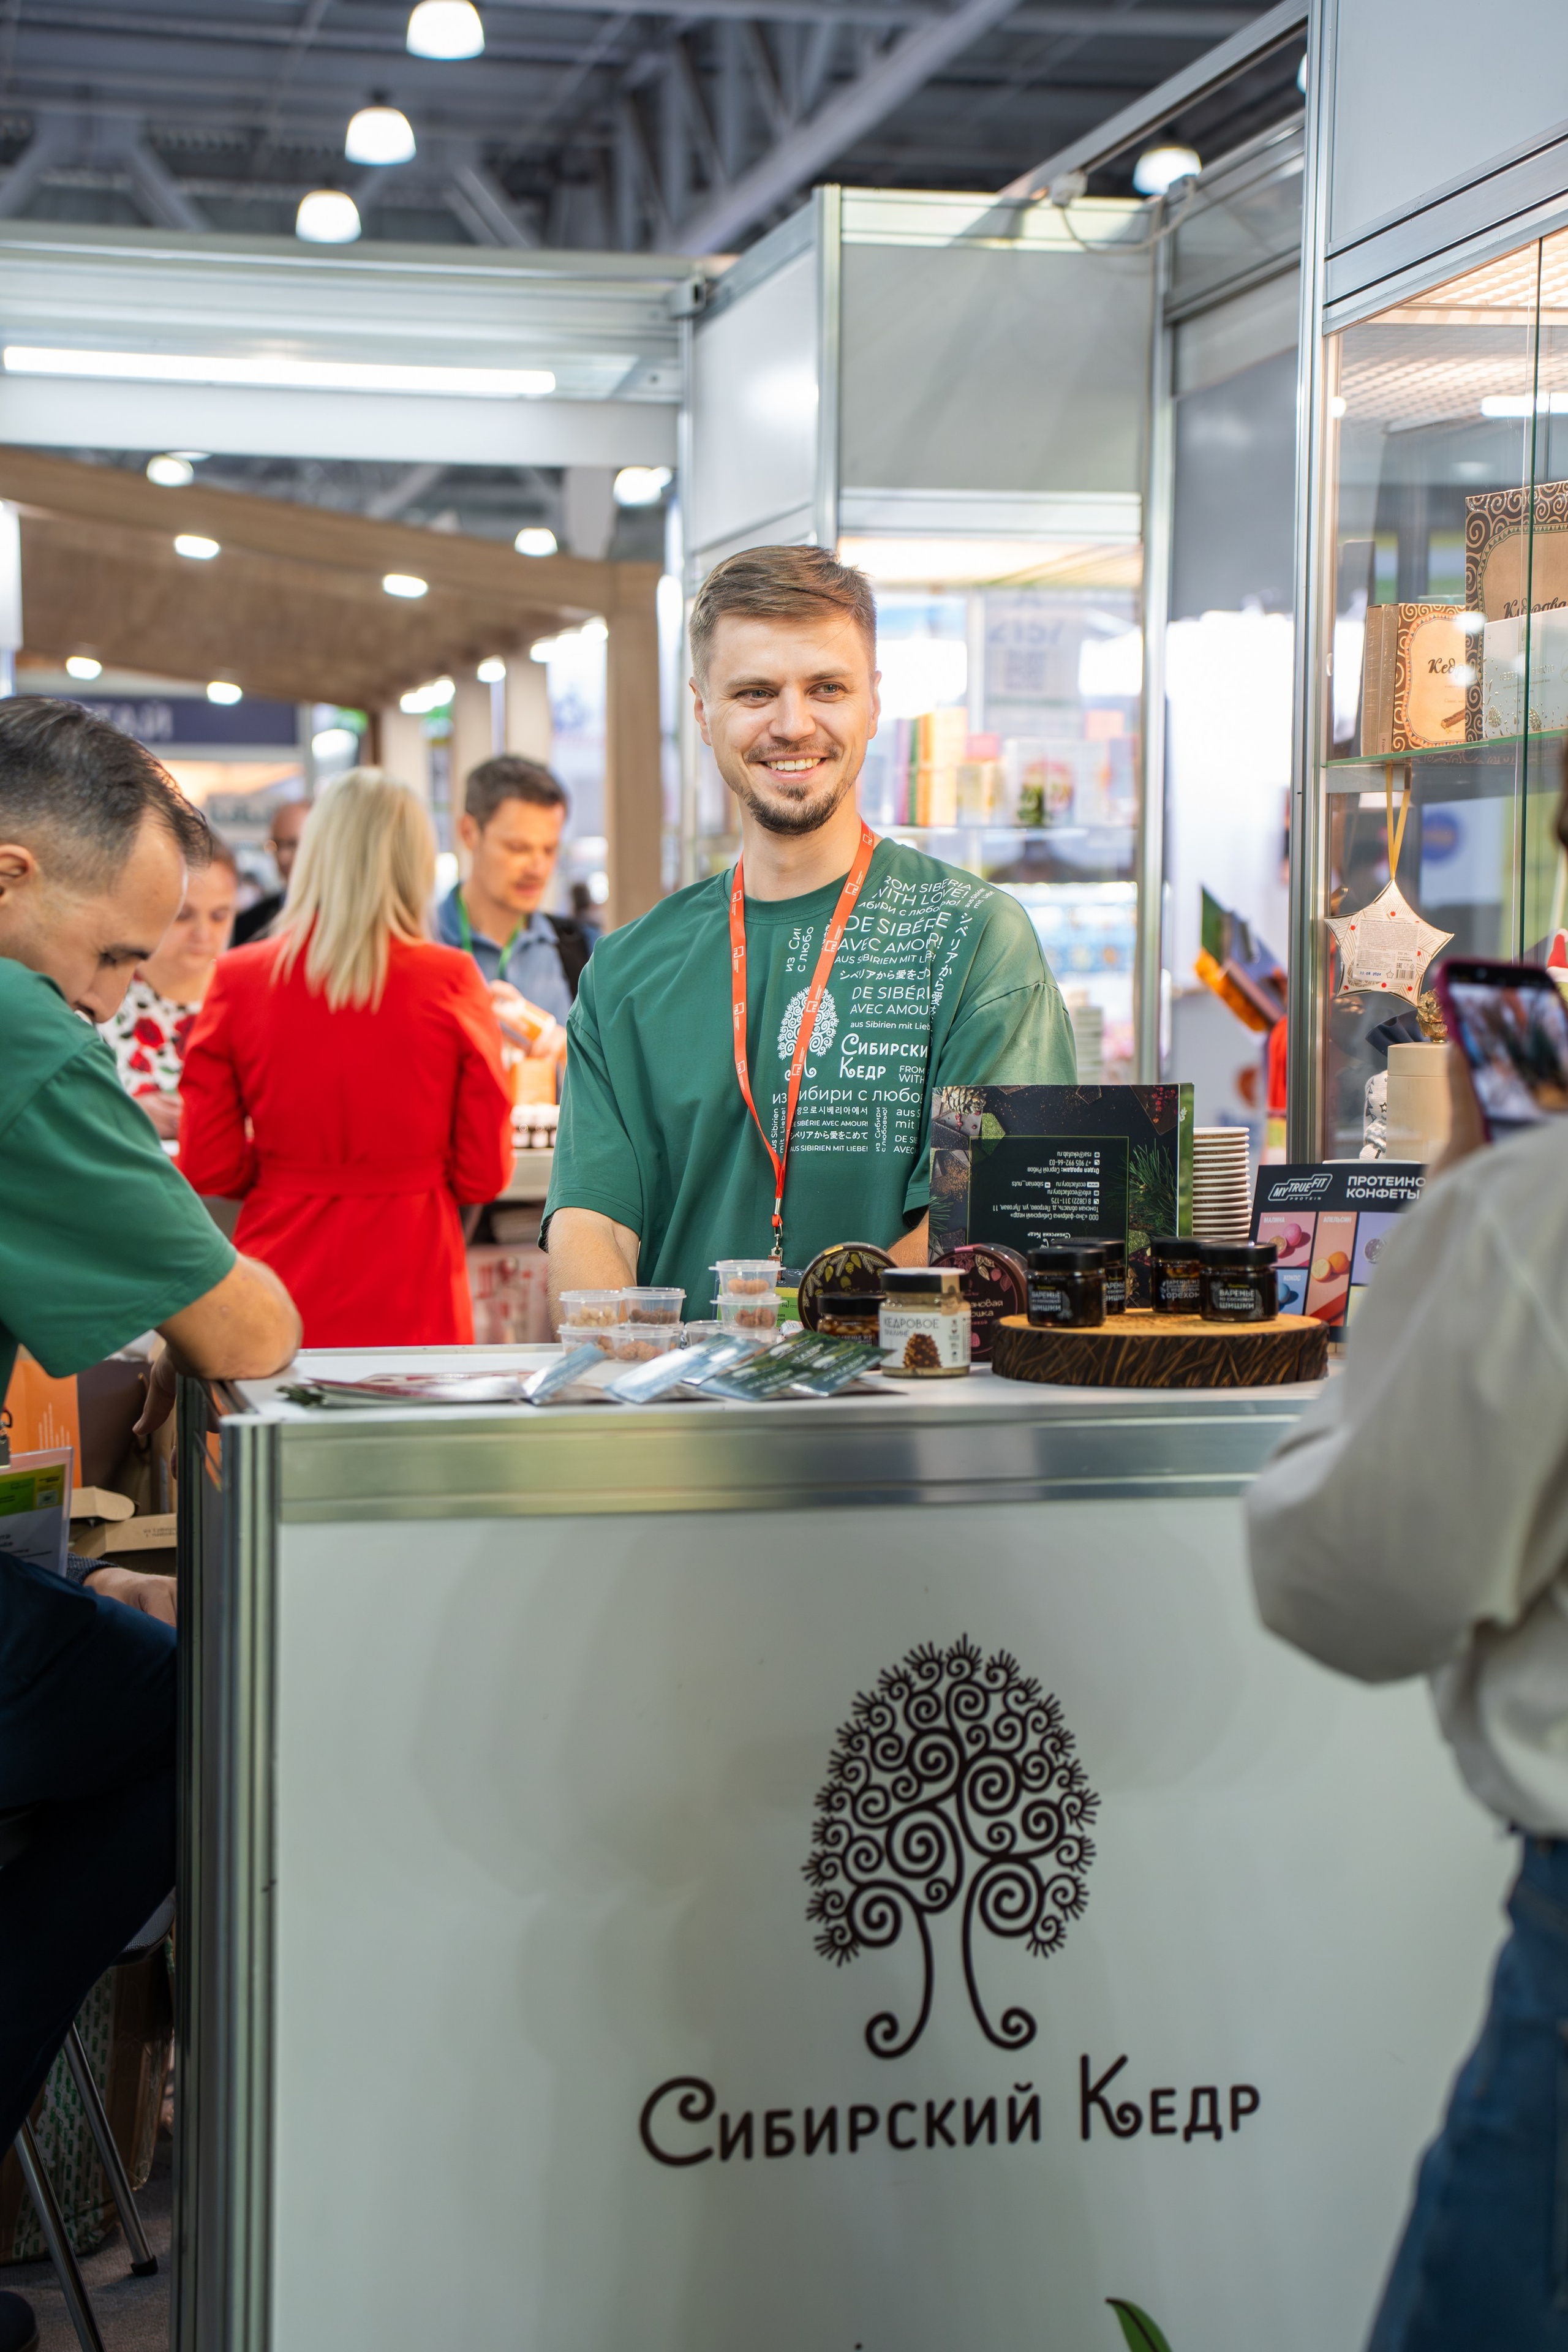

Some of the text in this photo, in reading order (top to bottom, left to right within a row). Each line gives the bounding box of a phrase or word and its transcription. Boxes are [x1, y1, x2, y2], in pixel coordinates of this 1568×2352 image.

[884, 875, 971, 893] ROM SIBERIA
[921, 886, 969, 905] LOVE!
[837, 932, 944, 954] AVEC AMOR!
[834, 955, 855, 964] AUS
[899, 954, 918, 964] MIT
[852, 984, 930, 1001] DE SIBÉRI
[850, 1003, 929, 1015] AVEC AMOU
[865, 1020, 897, 1029] Sibirien
[899, 1021, 913, 1030] mit
[899, 1065, 925, 1074] FROM
[799, 1085, 852, 1104] ибири
[797, 1106, 868, 1115] 랑으로시베리아에서
[896, 1109, 916, 1117] aus
[895, 1120, 915, 1129] mit
[895, 1134, 908, 1143] DE
[1348, 1175, 1427, 1187] ПРОТЕИНО
[1346, 1188, 1420, 1200] КОНФЕТЫ
[1219, 1289, 1254, 1297] ВАРЕНЬЕ
[971, 1298, 1003, 1308] ановая
[884, 1317, 940, 1330] КЕДРОВОЕ
